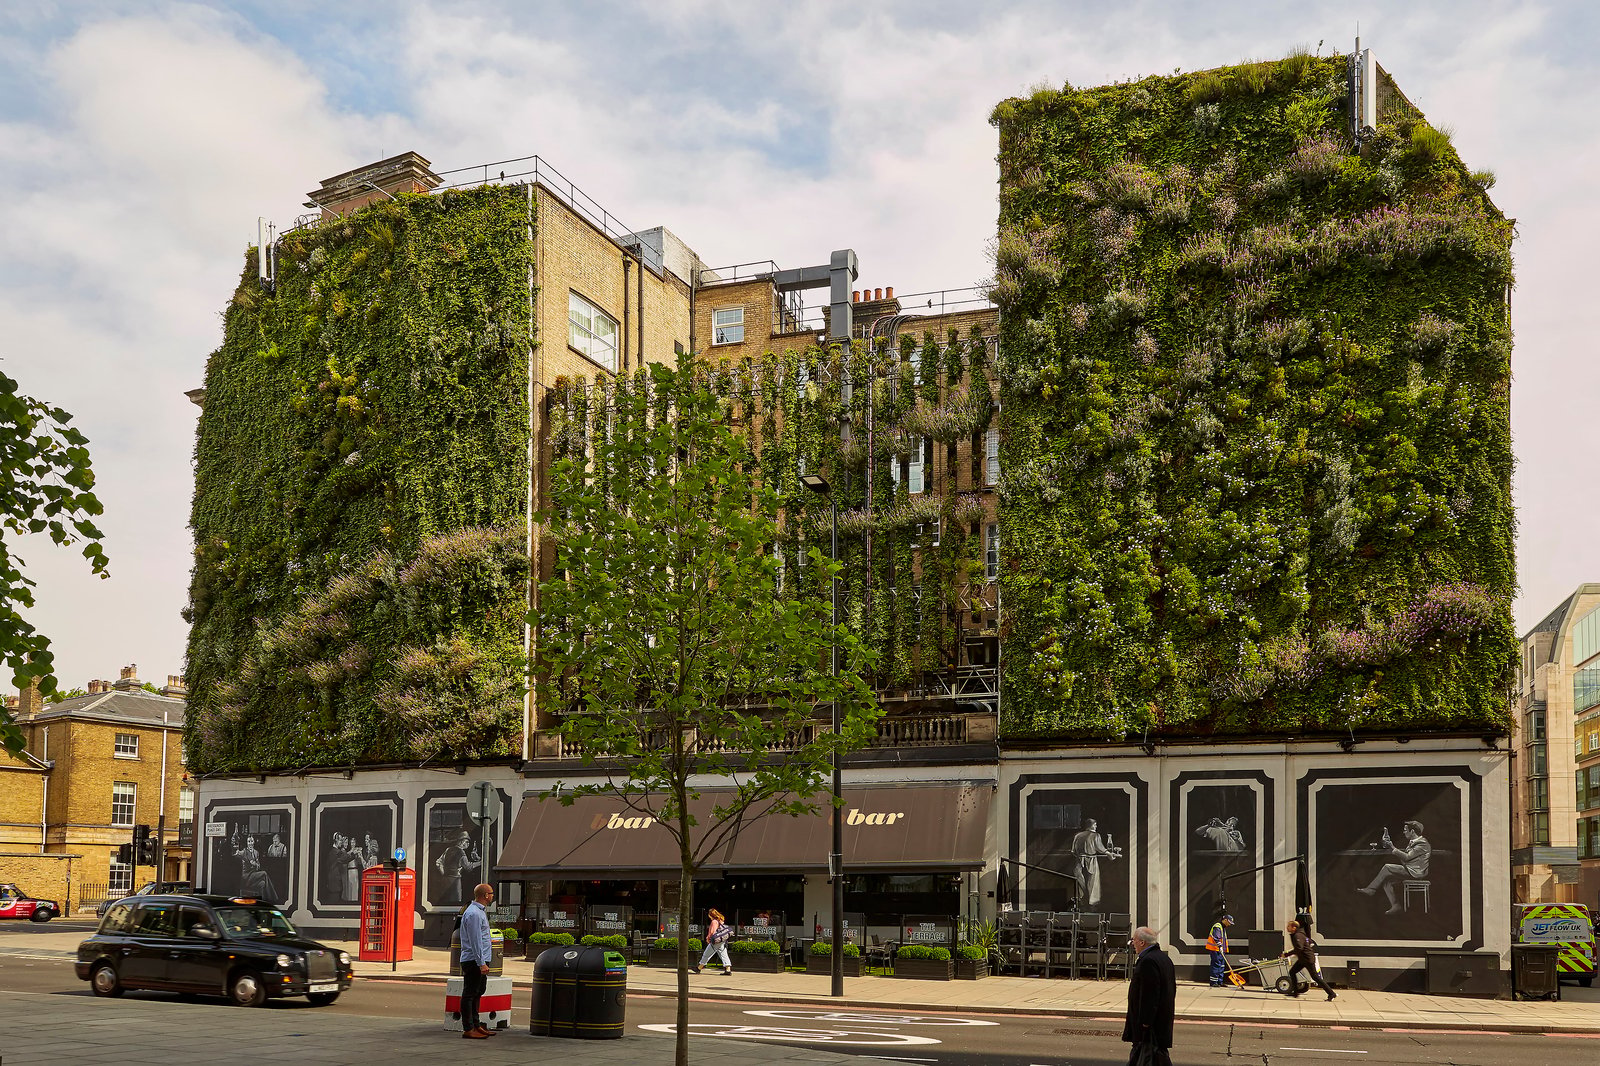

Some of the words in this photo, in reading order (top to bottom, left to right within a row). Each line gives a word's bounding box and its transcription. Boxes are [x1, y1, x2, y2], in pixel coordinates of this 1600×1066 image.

[828, 808, 905, 826] bar
[553, 911, 567, 920] THE
[604, 912, 618, 921] THE
[595, 920, 626, 930] TERRACE
[752, 917, 768, 926] THE
[743, 926, 777, 935] TERRACE
[919, 922, 936, 932] THE
[823, 928, 858, 938] TEACE
[910, 931, 945, 941] TERRACE
